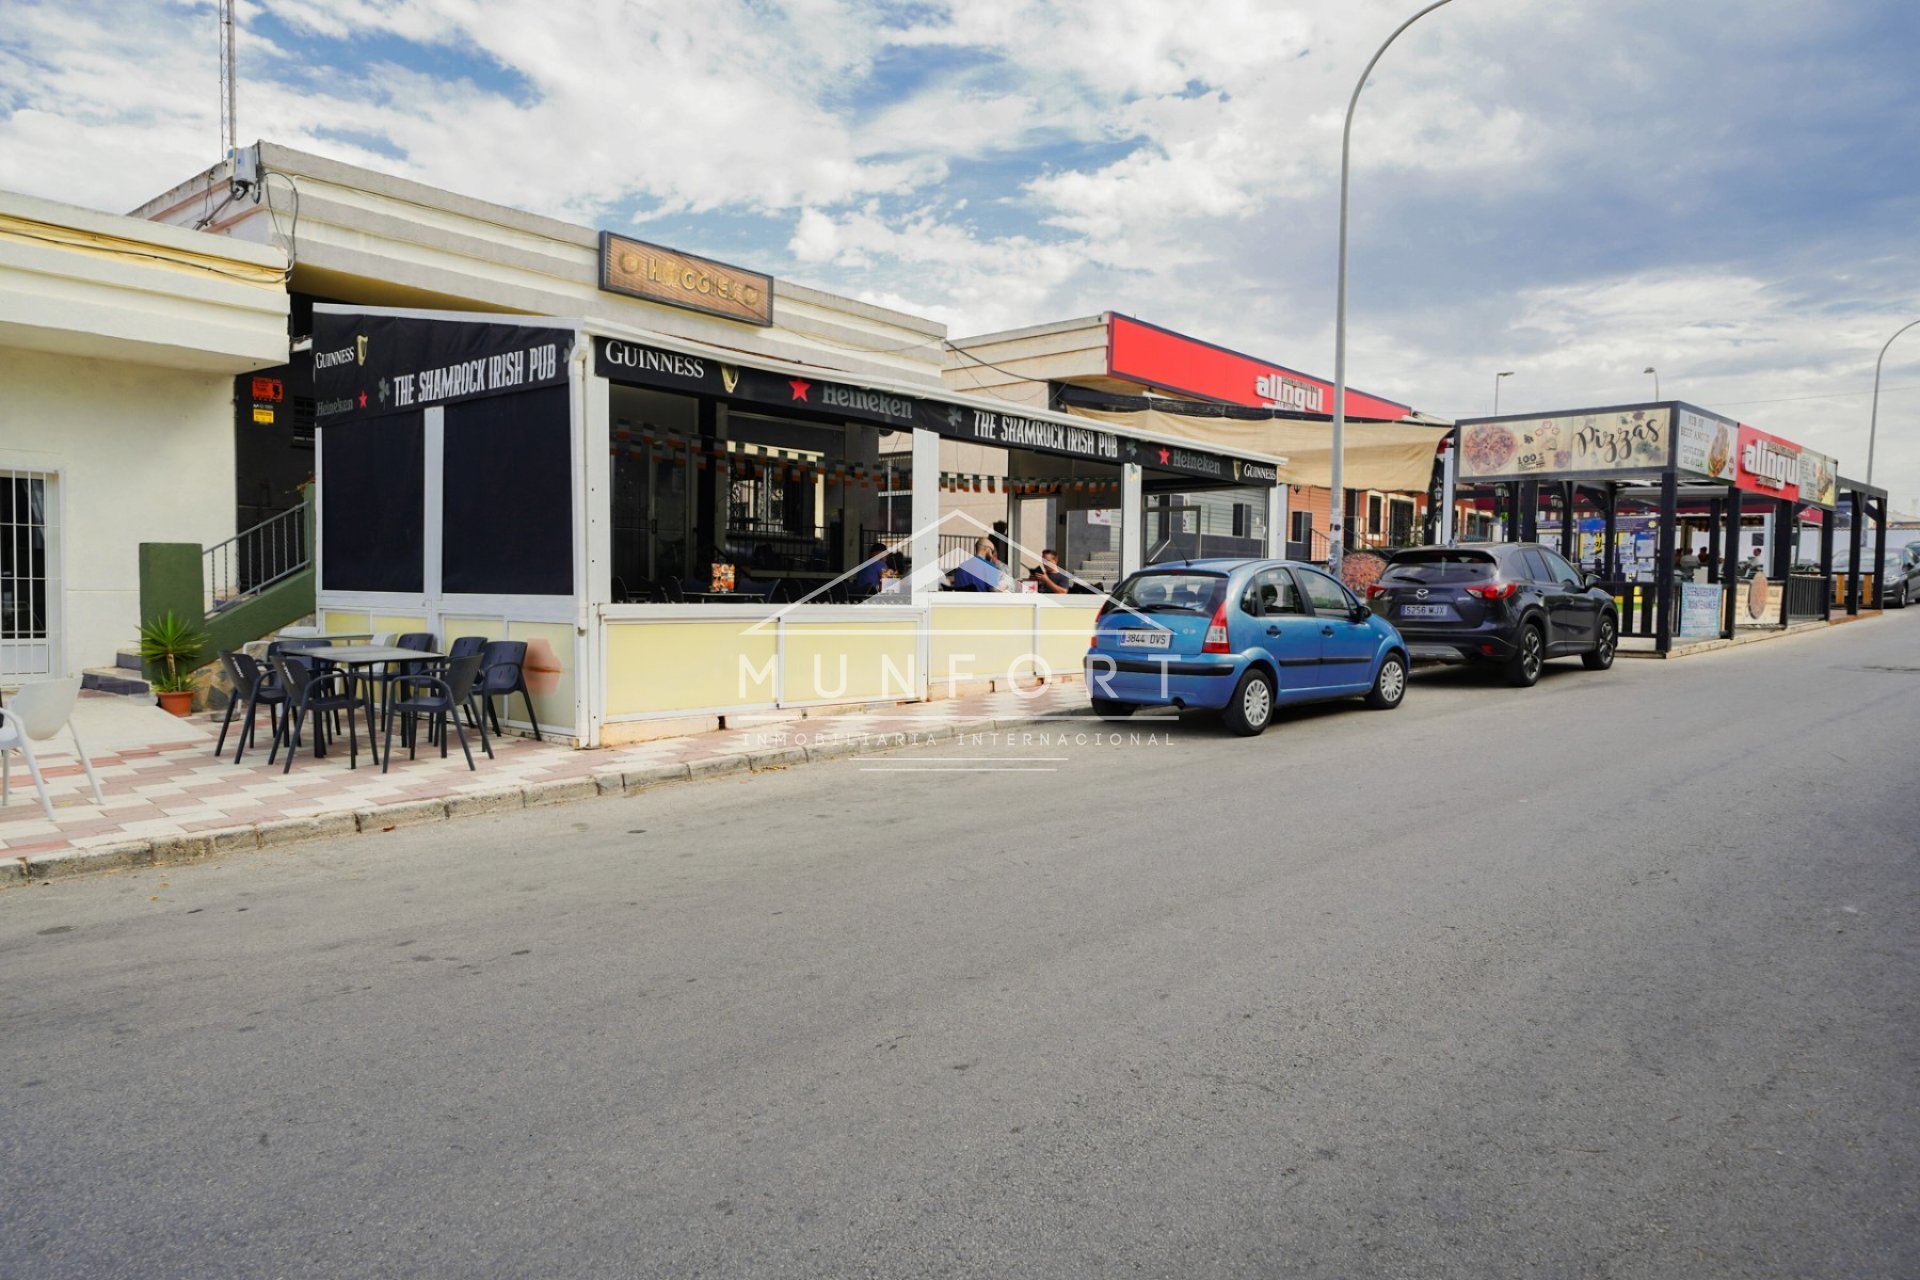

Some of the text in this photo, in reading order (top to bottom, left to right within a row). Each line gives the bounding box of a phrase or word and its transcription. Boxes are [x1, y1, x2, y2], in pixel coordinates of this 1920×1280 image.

[315, 346, 355, 369] GUINNESS
[393, 343, 557, 407] THE SHAMROCK IRISH PUB
[604, 340, 704, 379] GUINNESS
[316, 398, 354, 417] Heineken
[821, 381, 914, 419] Heineken
[973, 410, 1119, 458] THE SHAMROCK IRISH PUB
[1572, 418, 1664, 464] Pizzas
[1172, 449, 1221, 475] Heineken
[1243, 463, 1277, 480] GUINNESS
